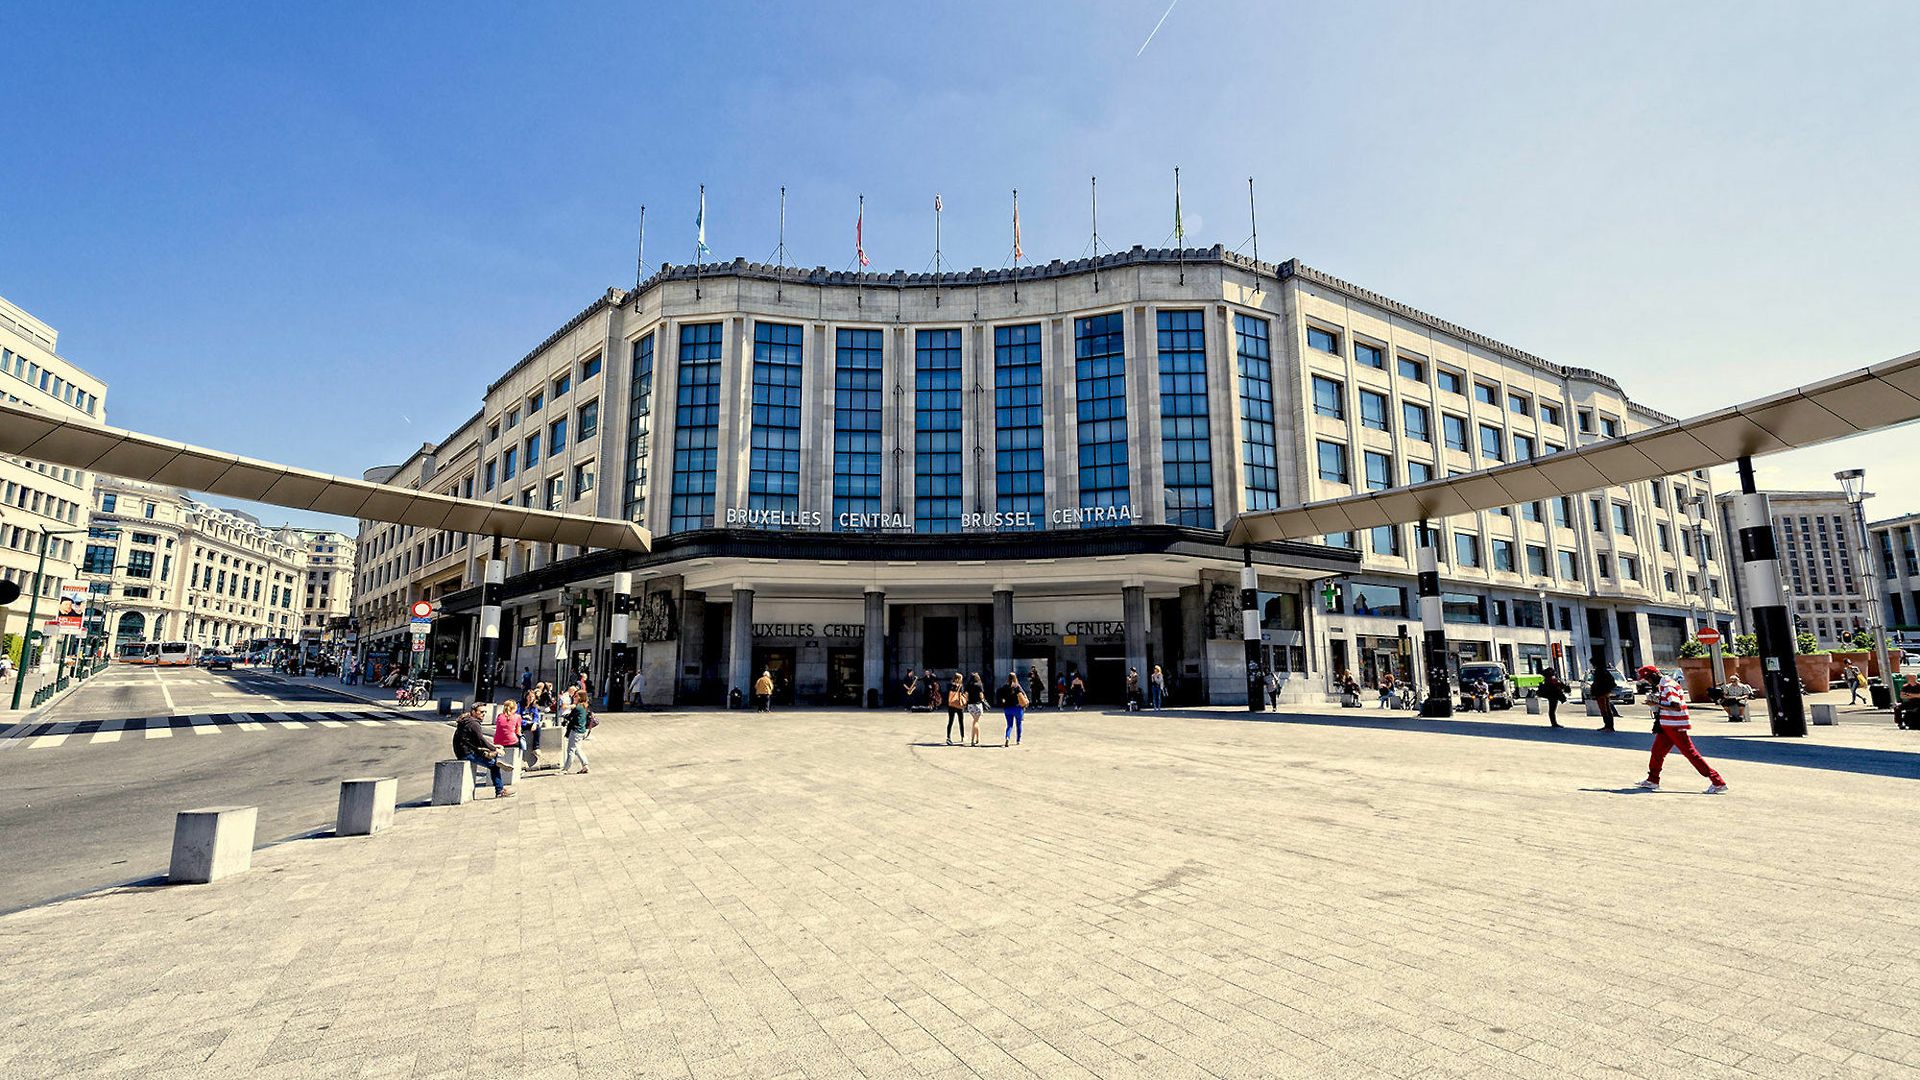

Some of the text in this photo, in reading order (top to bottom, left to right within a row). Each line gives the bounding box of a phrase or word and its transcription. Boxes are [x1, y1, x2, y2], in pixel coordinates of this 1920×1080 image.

[726, 508, 912, 528] BRUXELLES CENTRAL
[961, 504, 1142, 527] BRUSSEL CENTRAAL
[751, 623, 865, 638] RUXELLES CENTR
[1014, 621, 1125, 636] USSEL CENTRA
